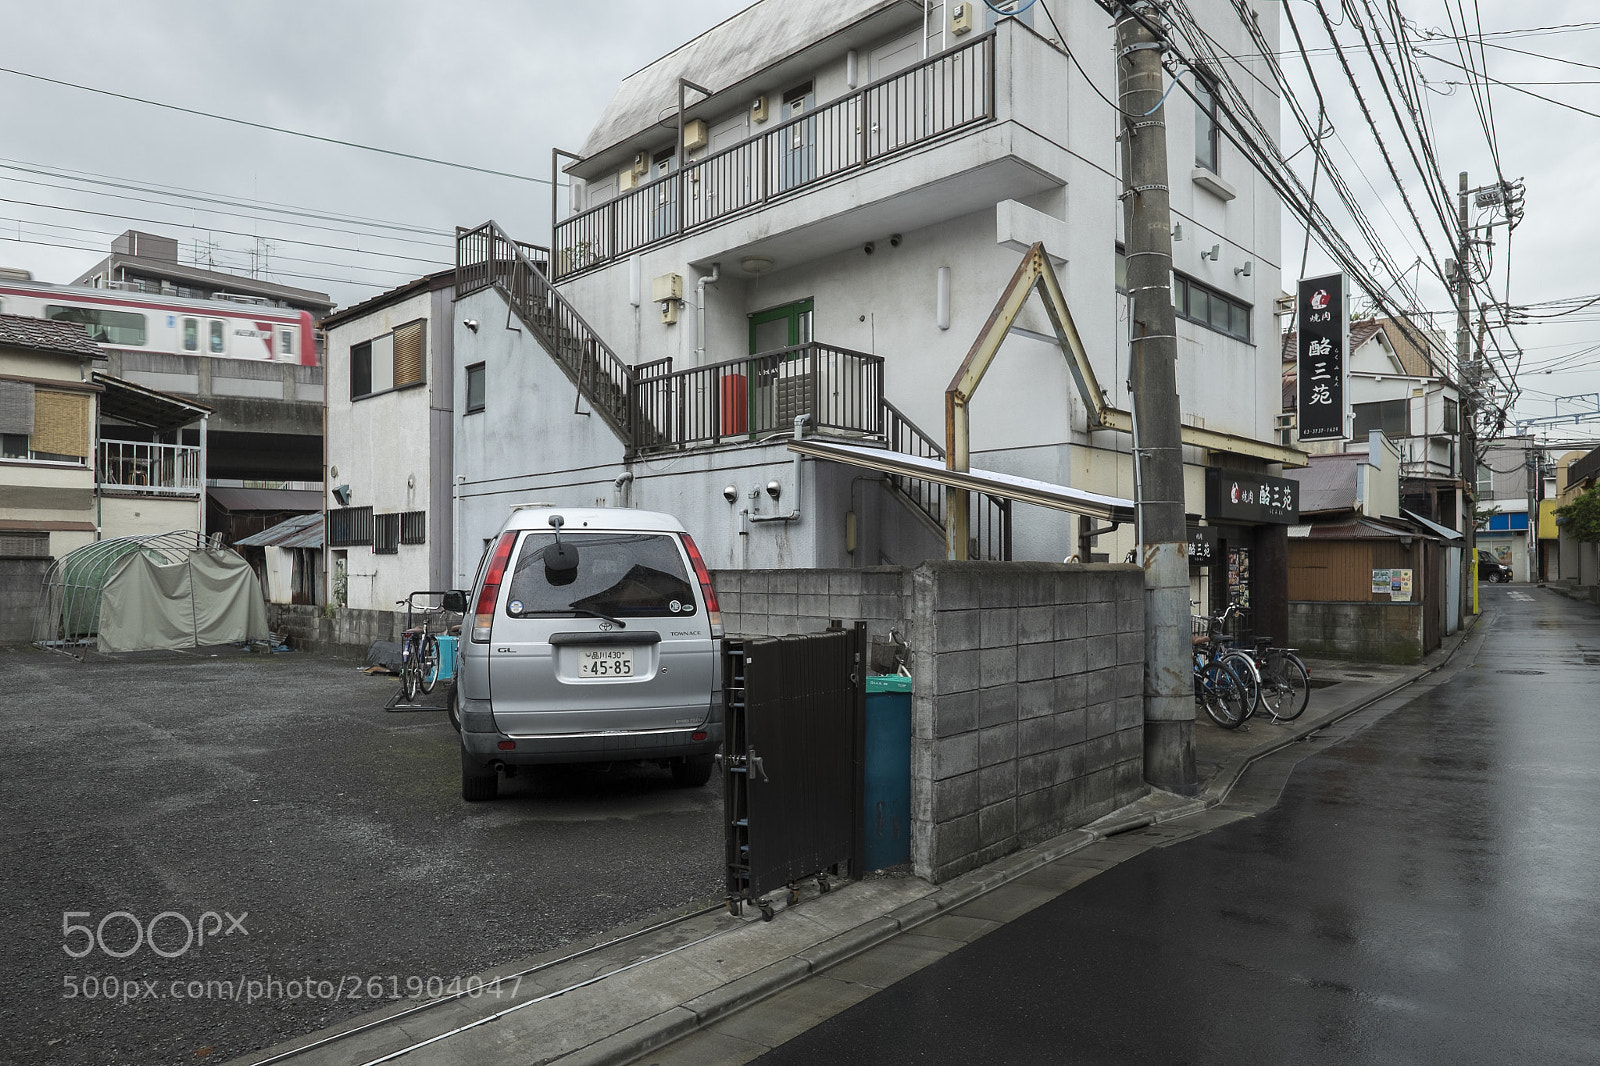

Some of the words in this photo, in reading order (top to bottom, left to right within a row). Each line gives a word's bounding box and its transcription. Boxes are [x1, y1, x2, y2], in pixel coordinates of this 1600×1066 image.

[1309, 311, 1331, 323] 焼肉
[1308, 337, 1333, 405] 酪三苑
[1241, 489, 1254, 505] 焼肉
[1259, 482, 1293, 511] 酪三苑
[590, 660, 631, 675] 45-85
